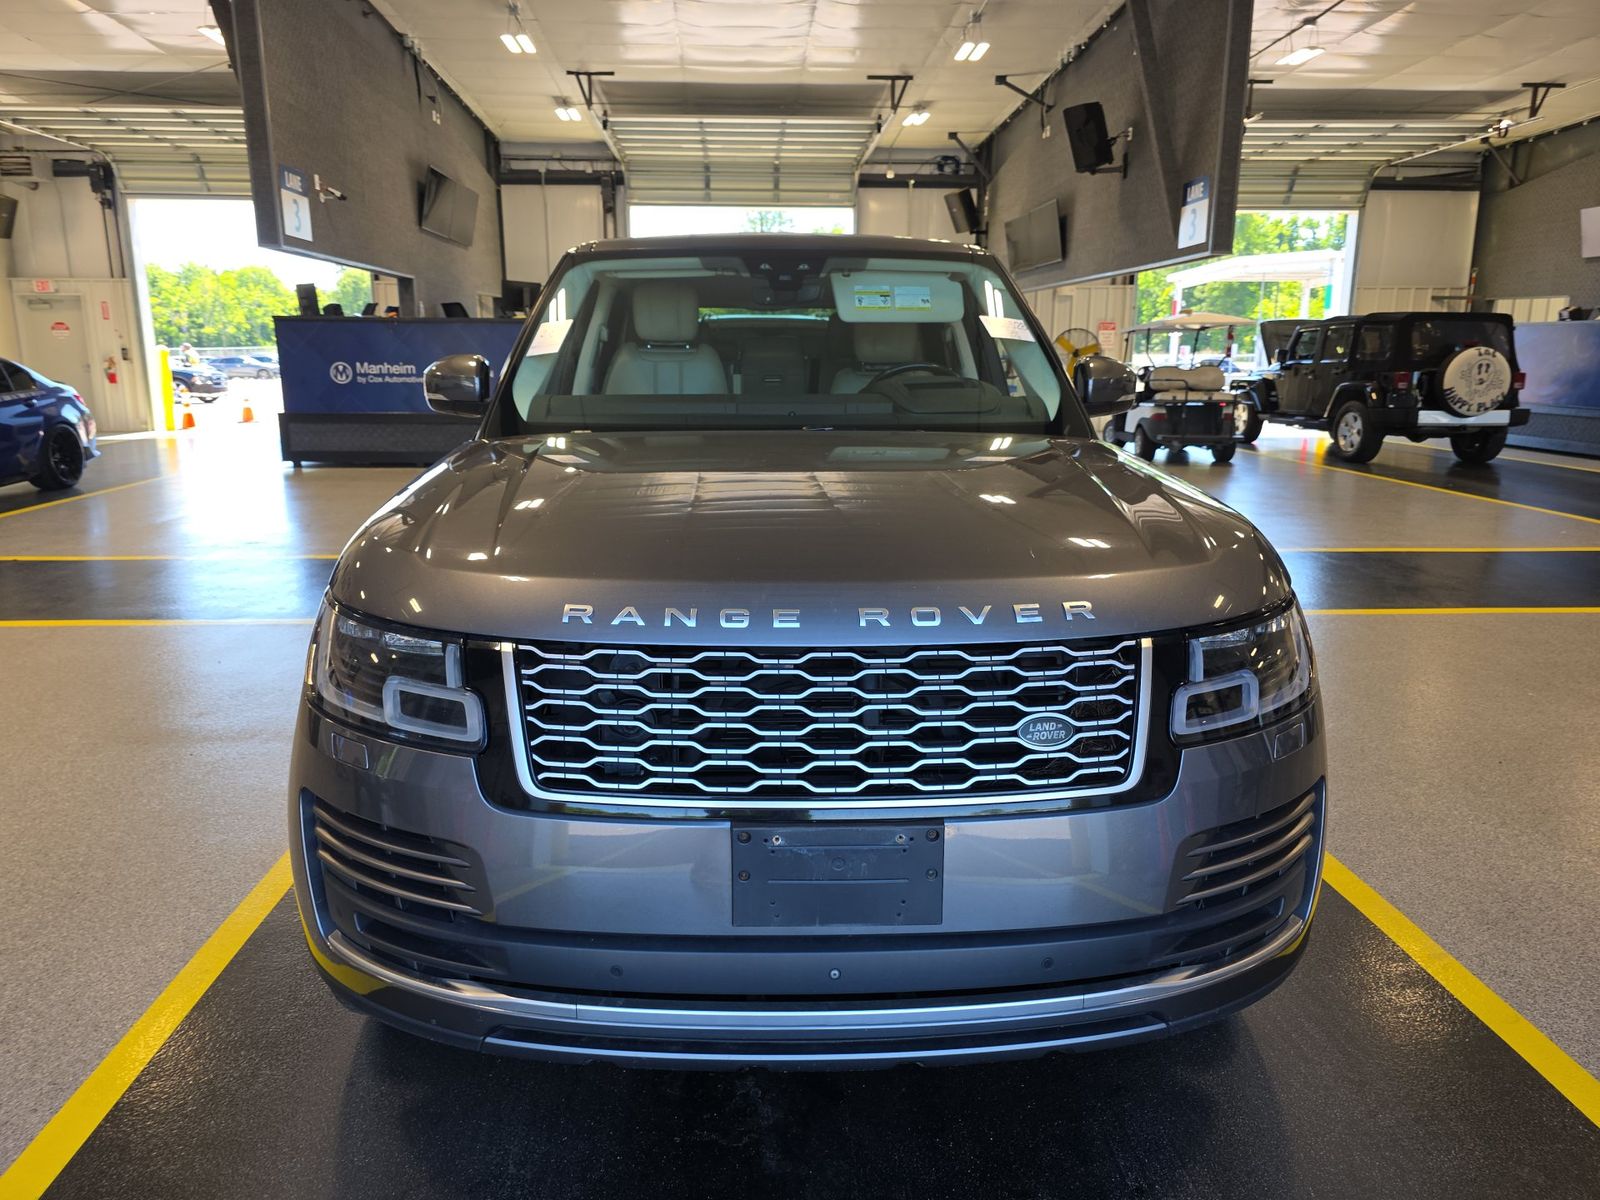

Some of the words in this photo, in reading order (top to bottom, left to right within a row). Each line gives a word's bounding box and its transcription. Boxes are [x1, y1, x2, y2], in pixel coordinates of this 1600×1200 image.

[1186, 181, 1204, 201] LANE
[292, 198, 302, 233] 3
[1189, 208, 1198, 241] 3
[356, 362, 416, 374] Manheim
[357, 376, 366, 384] by
[368, 375, 383, 383] Cox
[1443, 386, 1474, 412] HAPPY
[562, 603, 801, 628] RANGE
[858, 600, 1096, 627] ROVER
[1029, 722, 1057, 732] LAND
[1033, 730, 1065, 740] ROVER
